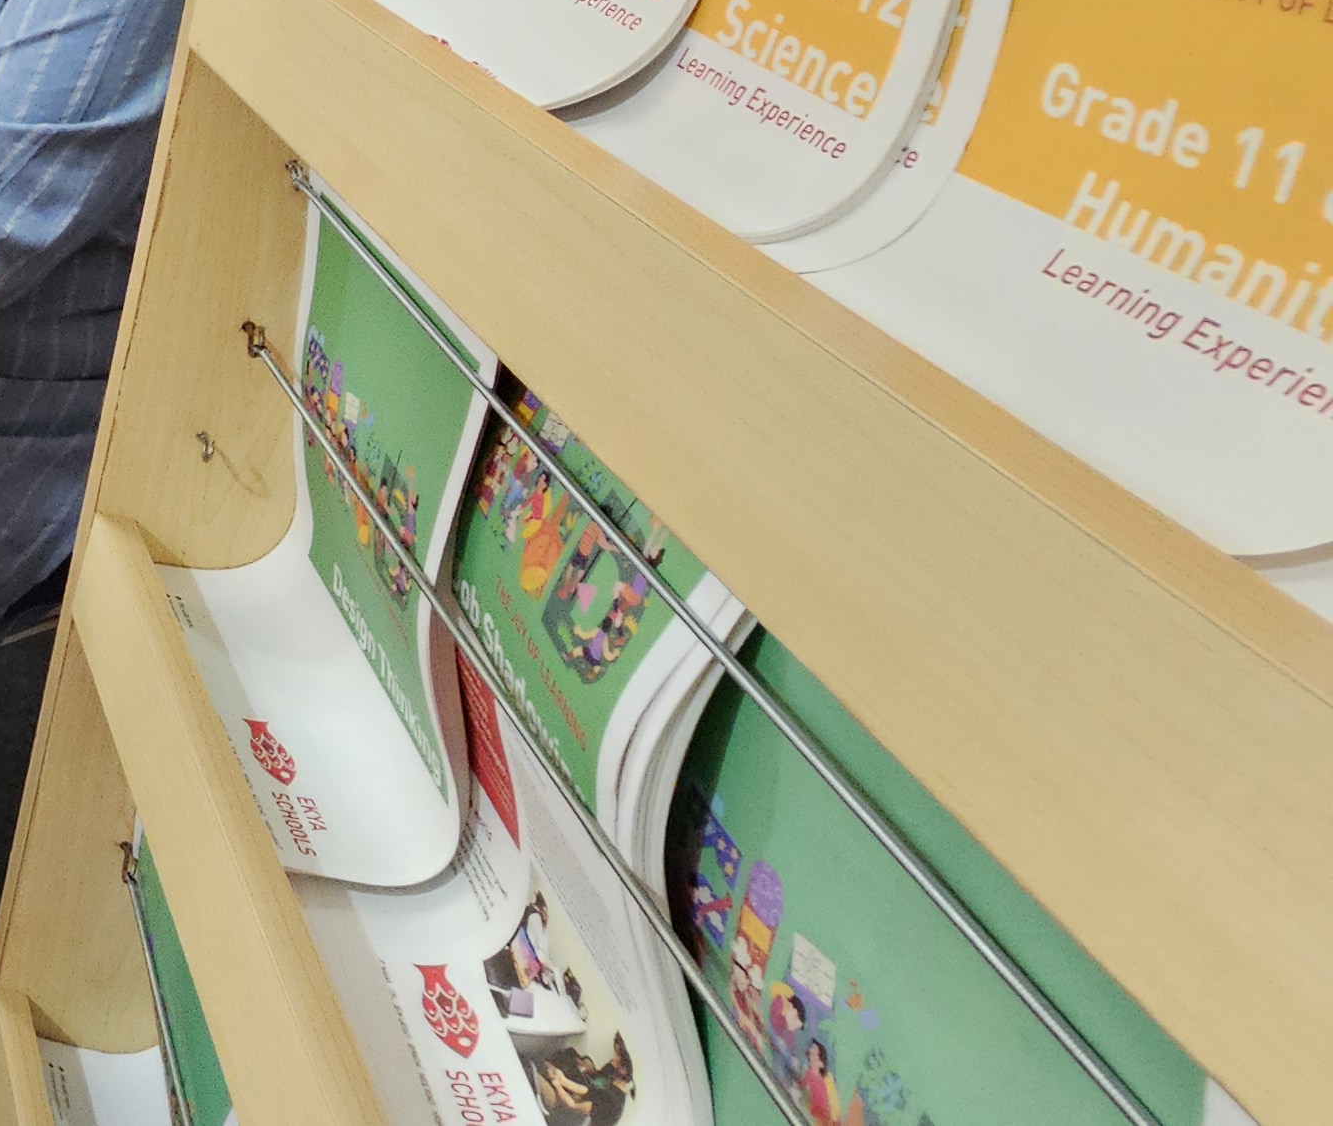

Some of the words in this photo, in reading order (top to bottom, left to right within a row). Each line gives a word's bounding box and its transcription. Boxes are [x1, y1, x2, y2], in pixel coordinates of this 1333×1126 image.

[677, 46, 749, 100] Learning
[745, 88, 848, 161] Experience
[1040, 61, 1211, 171] Grade
[1234, 125, 1308, 206] 11
[1042, 248, 1184, 341] Learning
[460, 579, 481, 627] ob
[272, 790, 318, 858] SCHOOLS
[297, 795, 328, 833] EKYA
[478, 1070, 518, 1125] EKYA
